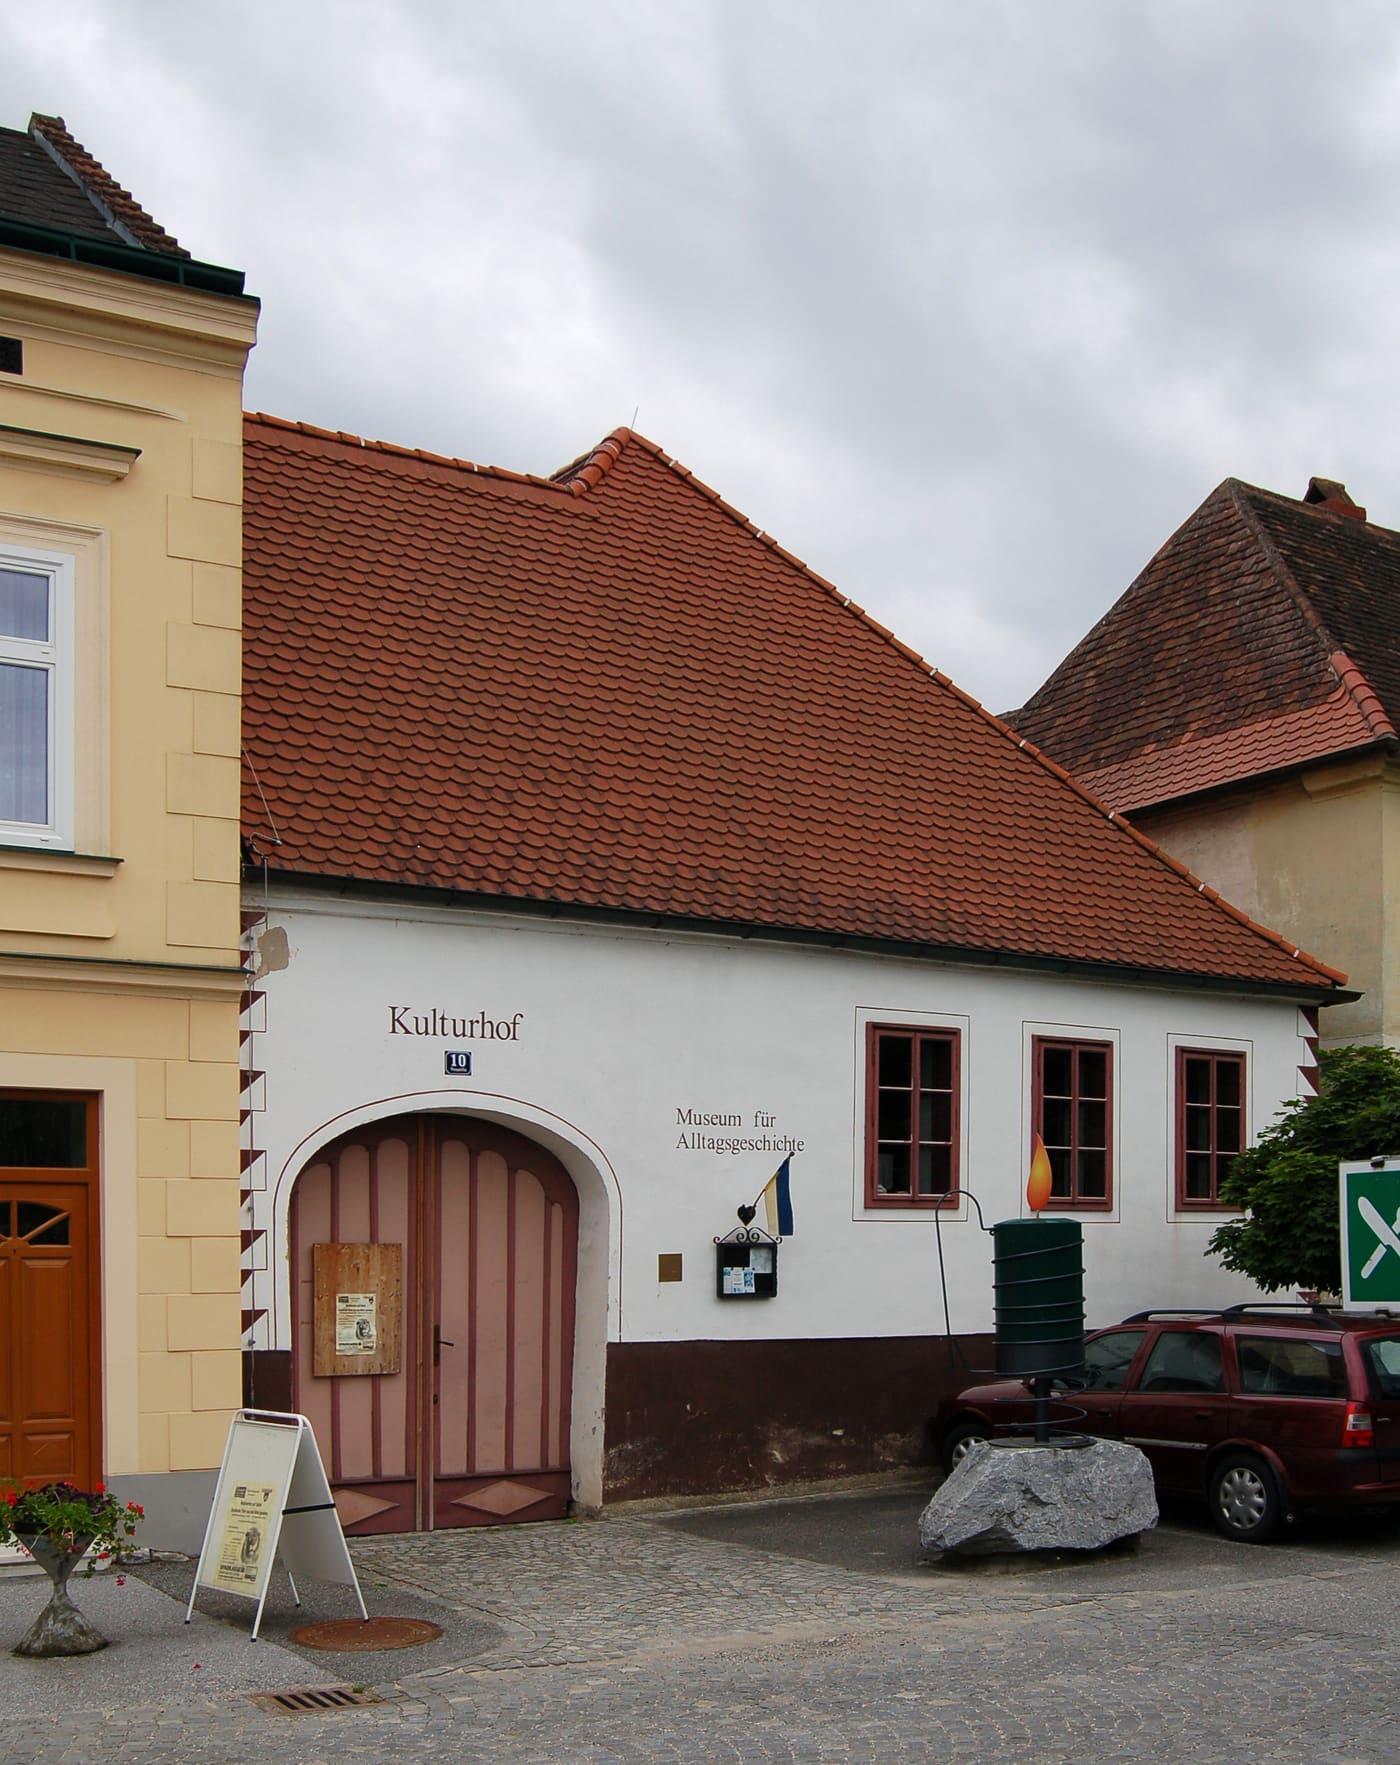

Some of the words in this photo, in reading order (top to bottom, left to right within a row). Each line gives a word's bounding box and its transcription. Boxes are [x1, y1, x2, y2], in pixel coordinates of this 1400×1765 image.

[388, 1005, 524, 1041] Kulturhof
[450, 1053, 466, 1067] 10
[676, 1107, 742, 1127] Museum
[753, 1110, 777, 1128] für
[676, 1132, 805, 1155] Alltagsgeschichte
